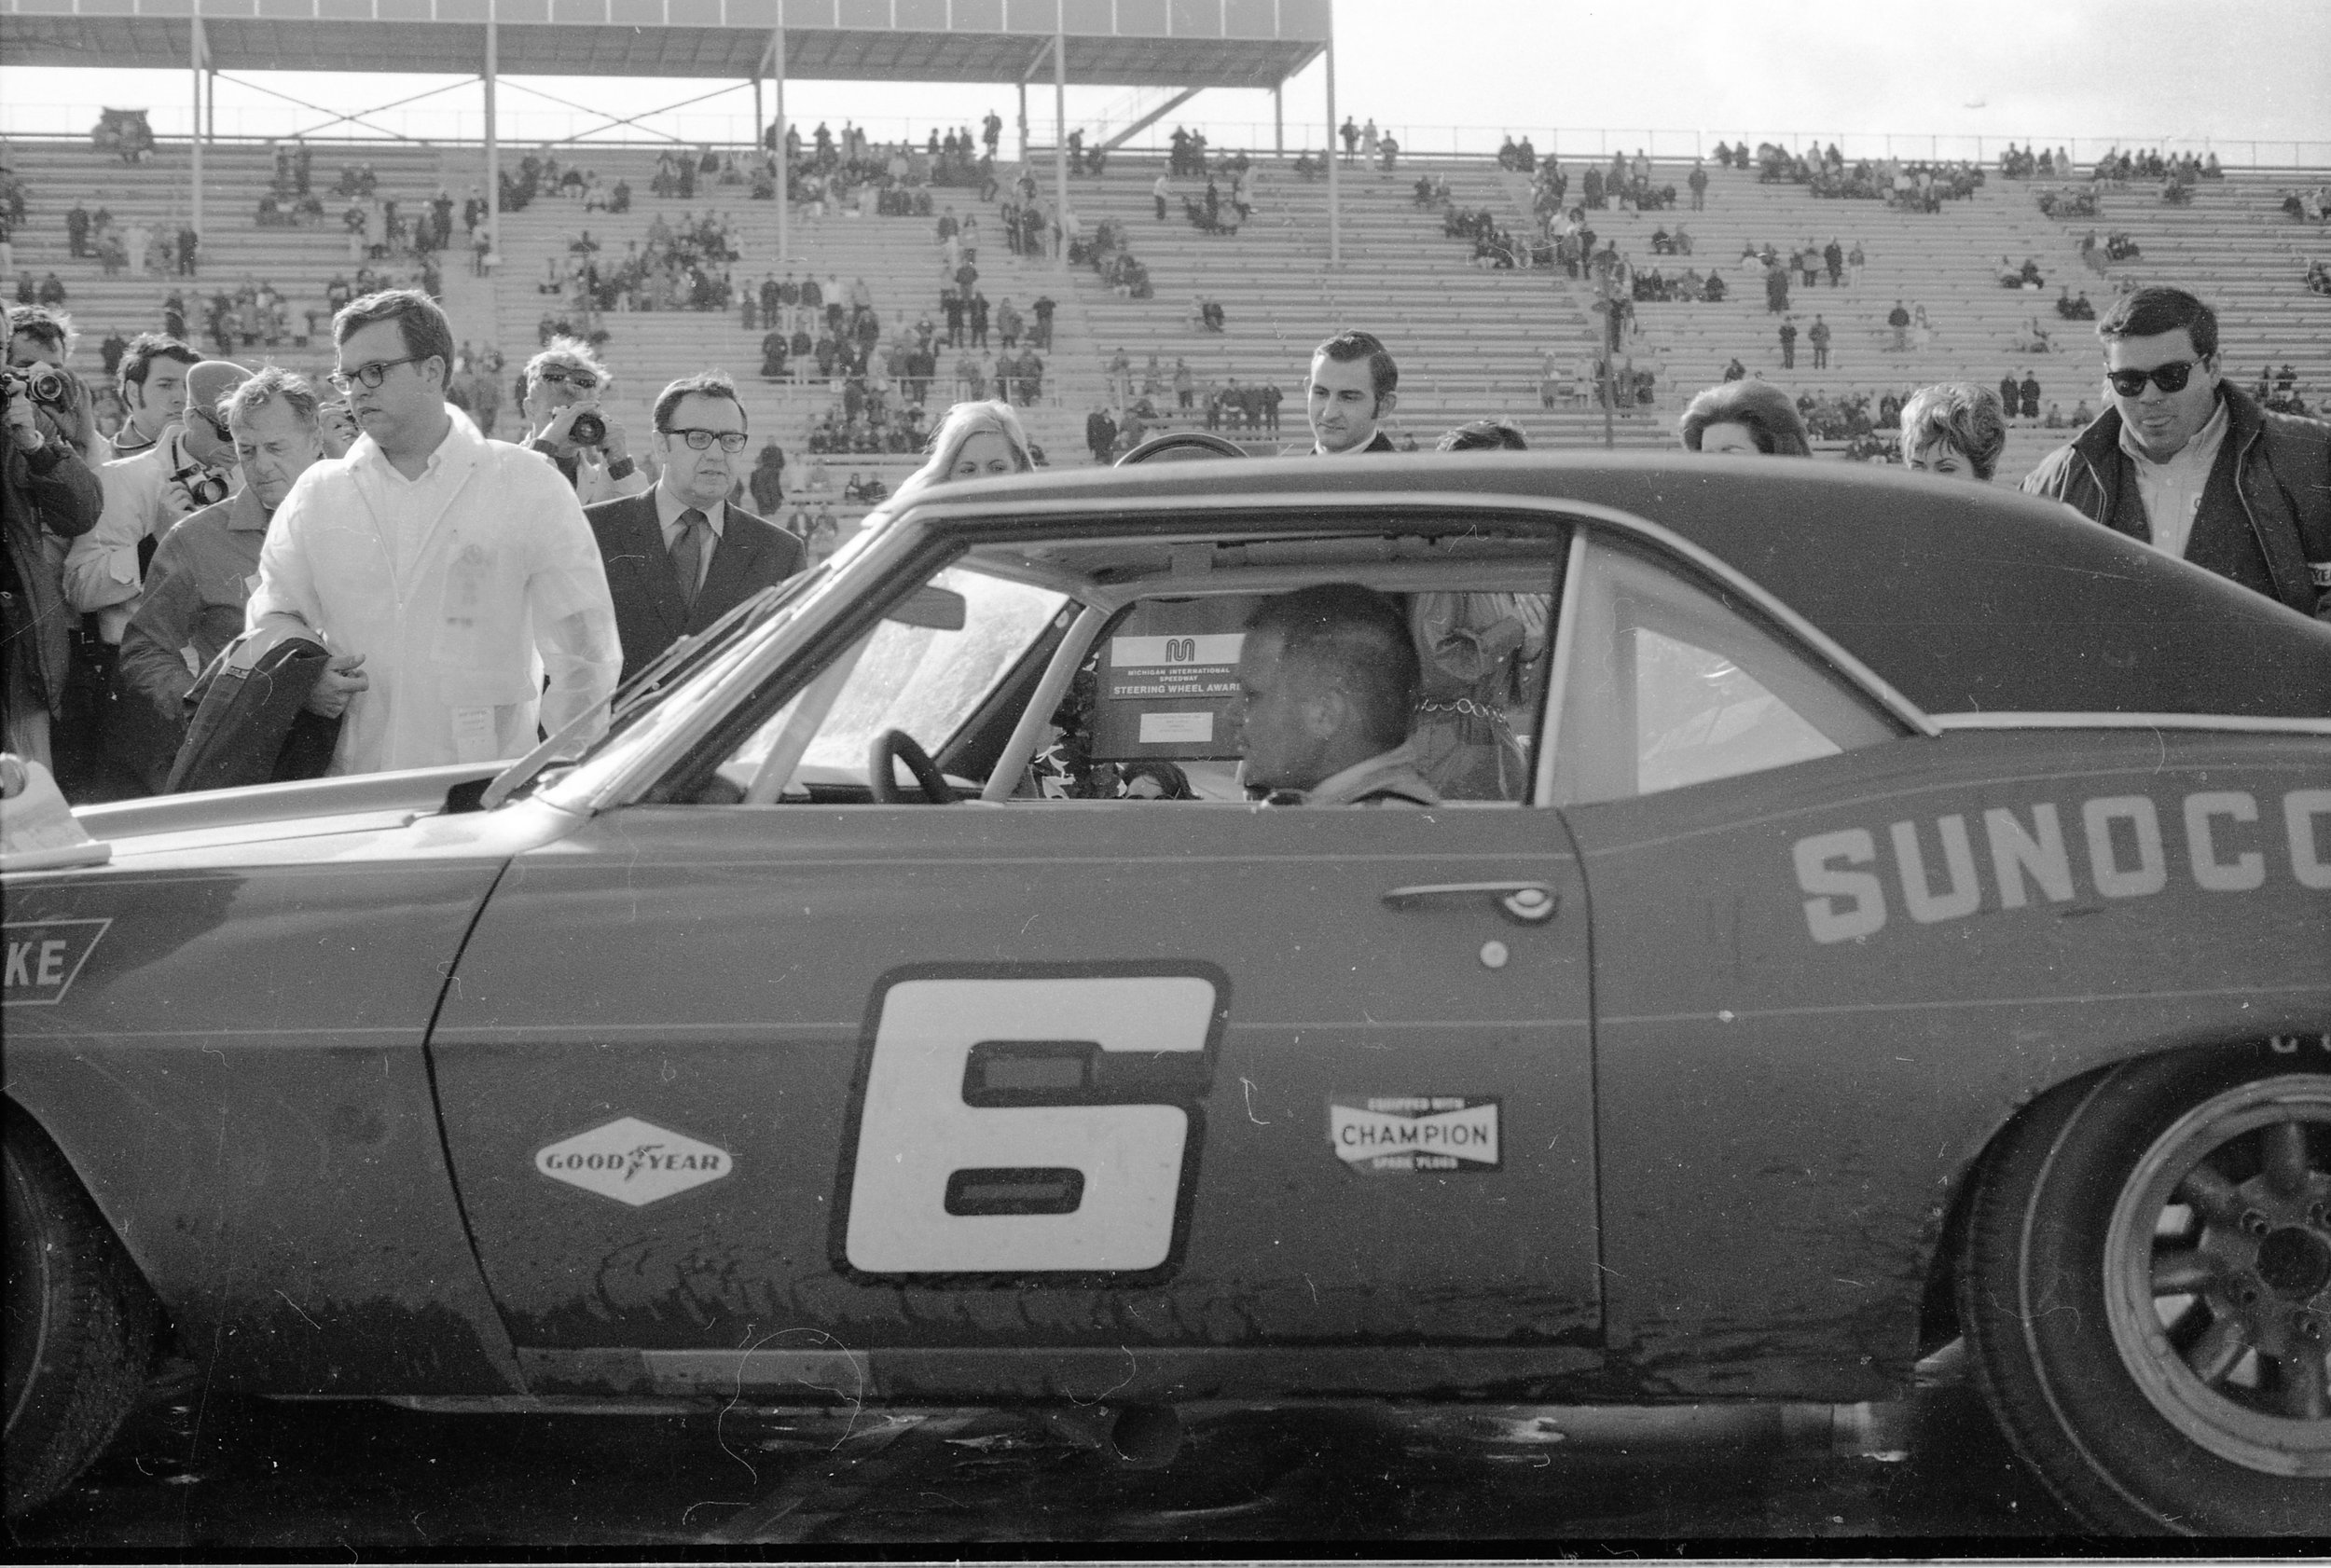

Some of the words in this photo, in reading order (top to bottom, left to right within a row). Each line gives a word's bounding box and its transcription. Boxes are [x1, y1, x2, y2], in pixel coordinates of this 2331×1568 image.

[1113, 684, 1166, 695] STEERING
[1168, 683, 1205, 693] WHEEL
[846, 977, 1216, 1272] 6
[1342, 1124, 1488, 1146] CHAMPION
